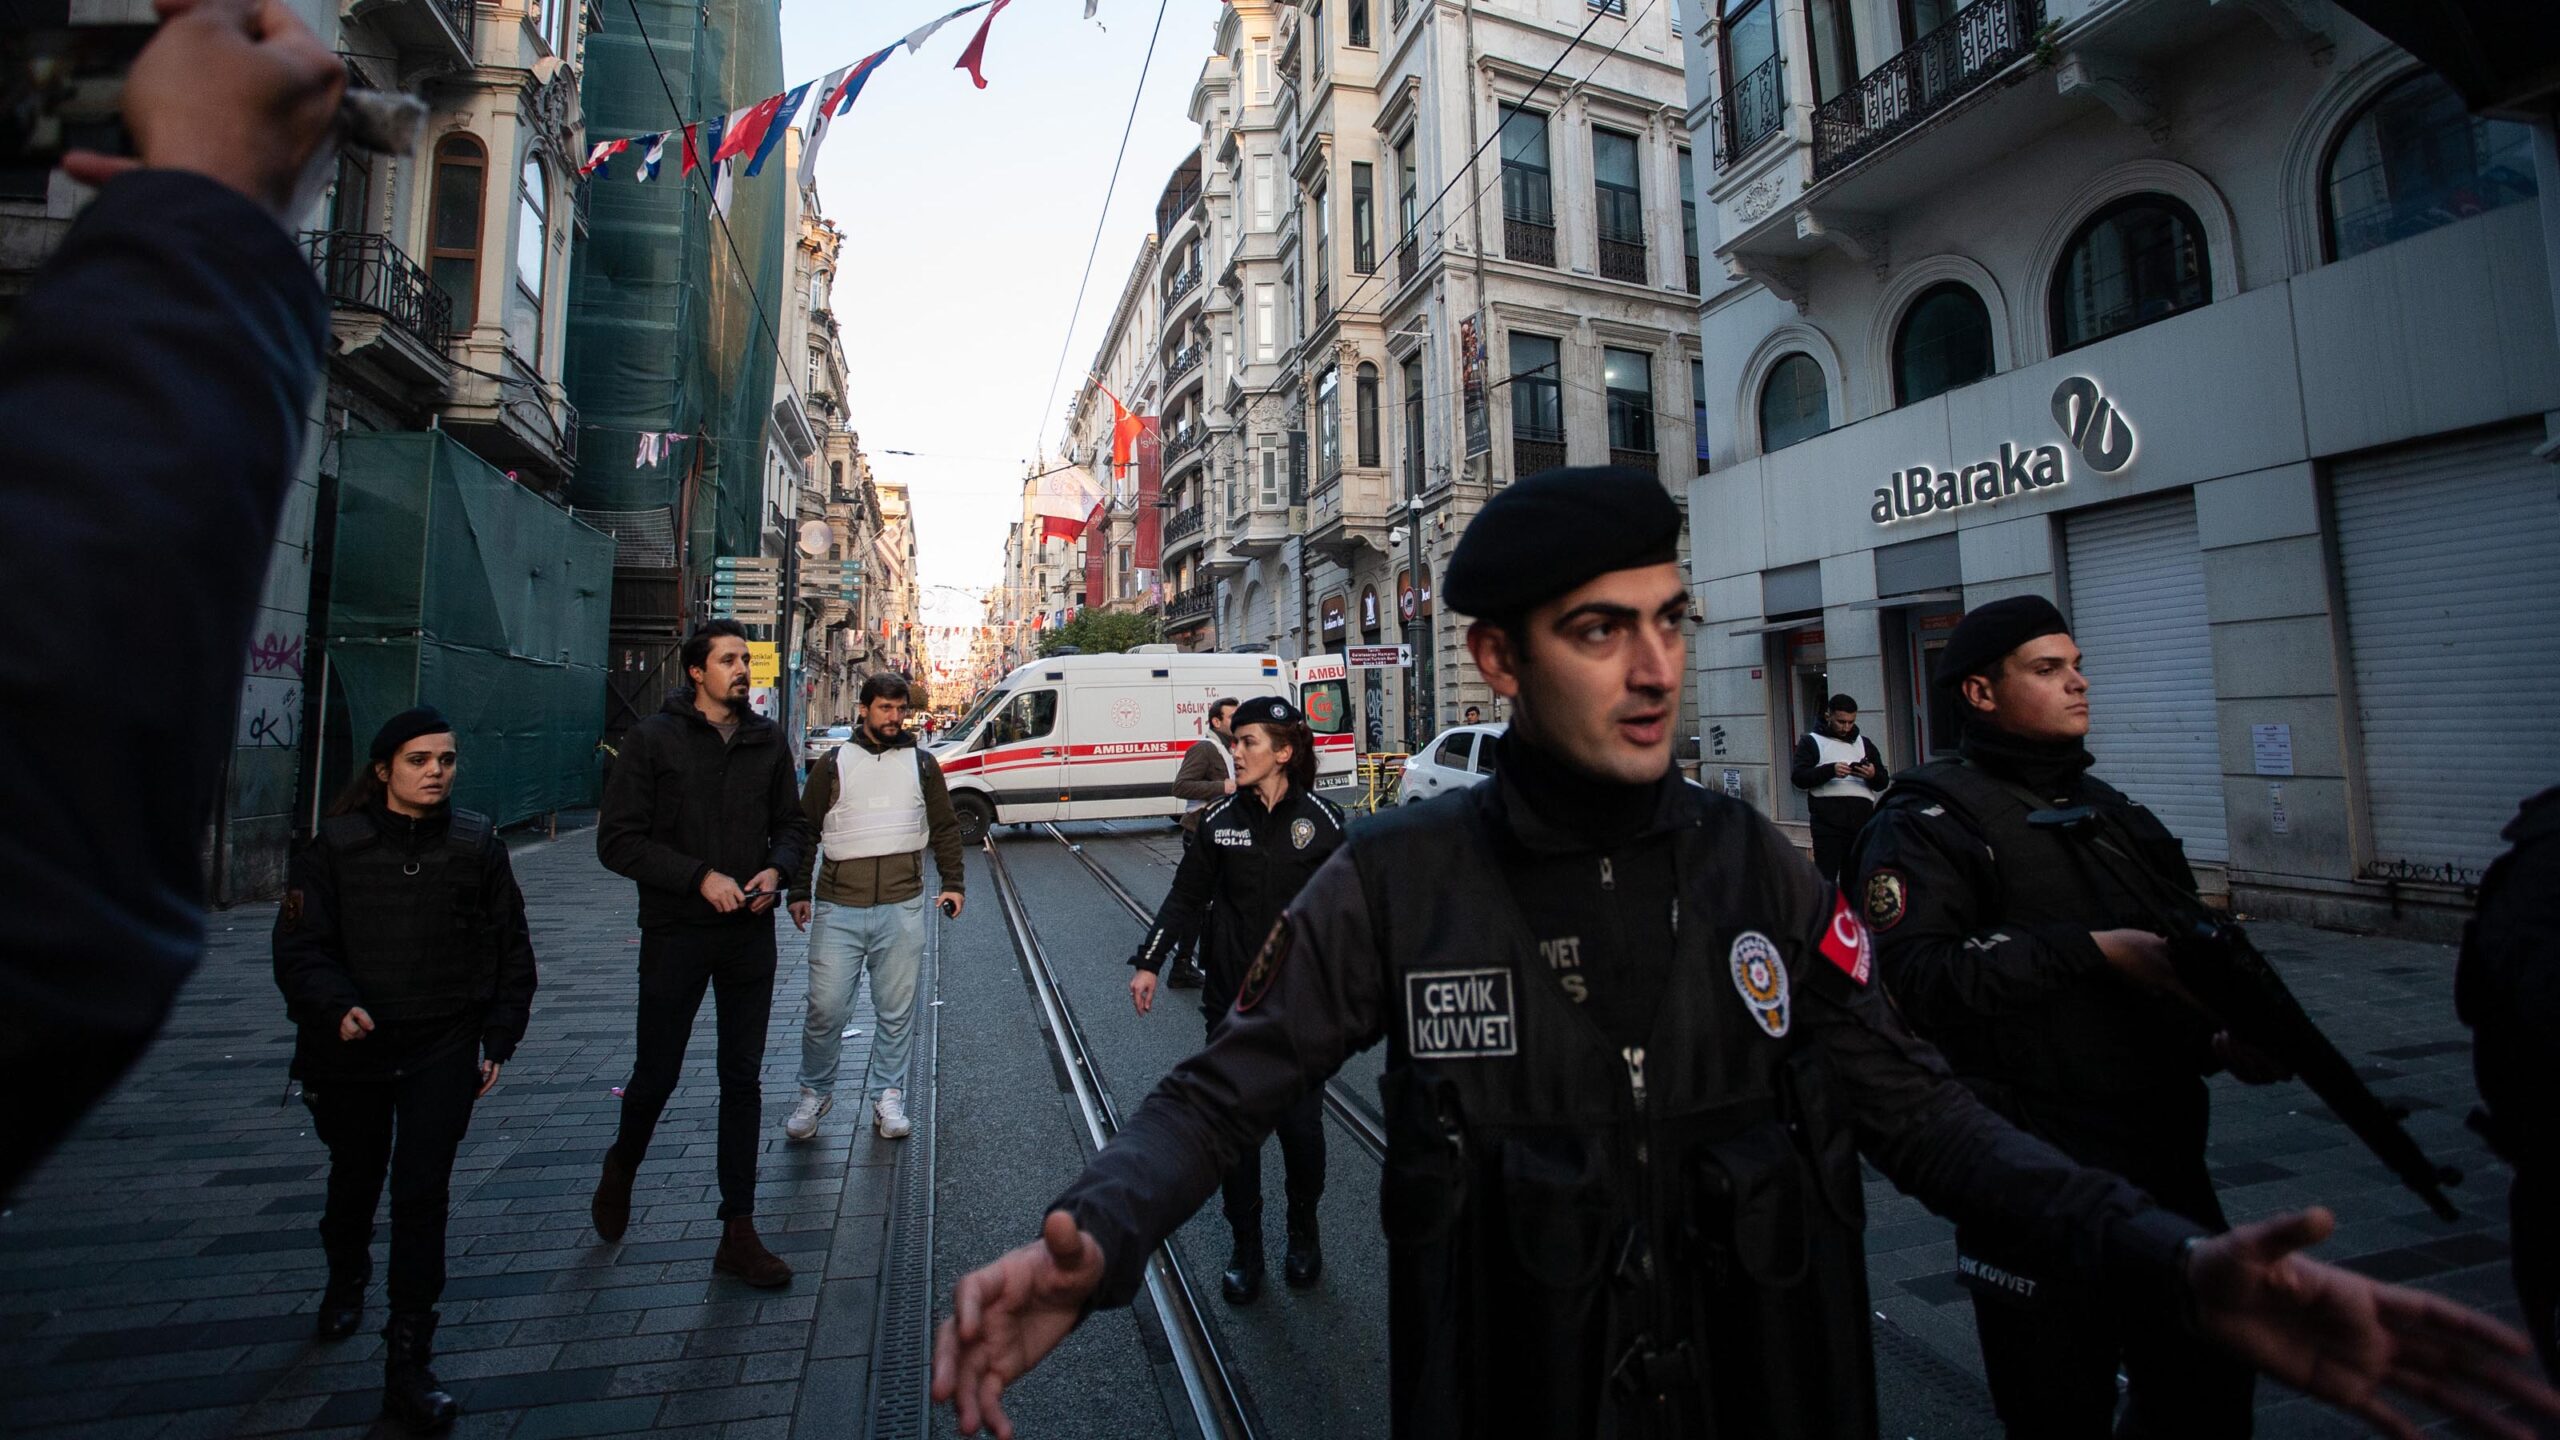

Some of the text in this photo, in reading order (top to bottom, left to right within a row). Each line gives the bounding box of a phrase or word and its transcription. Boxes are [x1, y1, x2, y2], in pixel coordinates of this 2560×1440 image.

[1870, 442, 2065, 524] alBaraka
[1308, 666, 1345, 680] AMBU
[1205, 687, 1220, 698] T.C.
[1176, 700, 1206, 714] SAĞLIK
[1093, 743, 1169, 755] AMBULANS
[1424, 975, 1497, 1018] ÇEVİK
[1417, 1014, 1510, 1051] KUVVET
[1978, 1263, 2037, 1297] KUVVET
